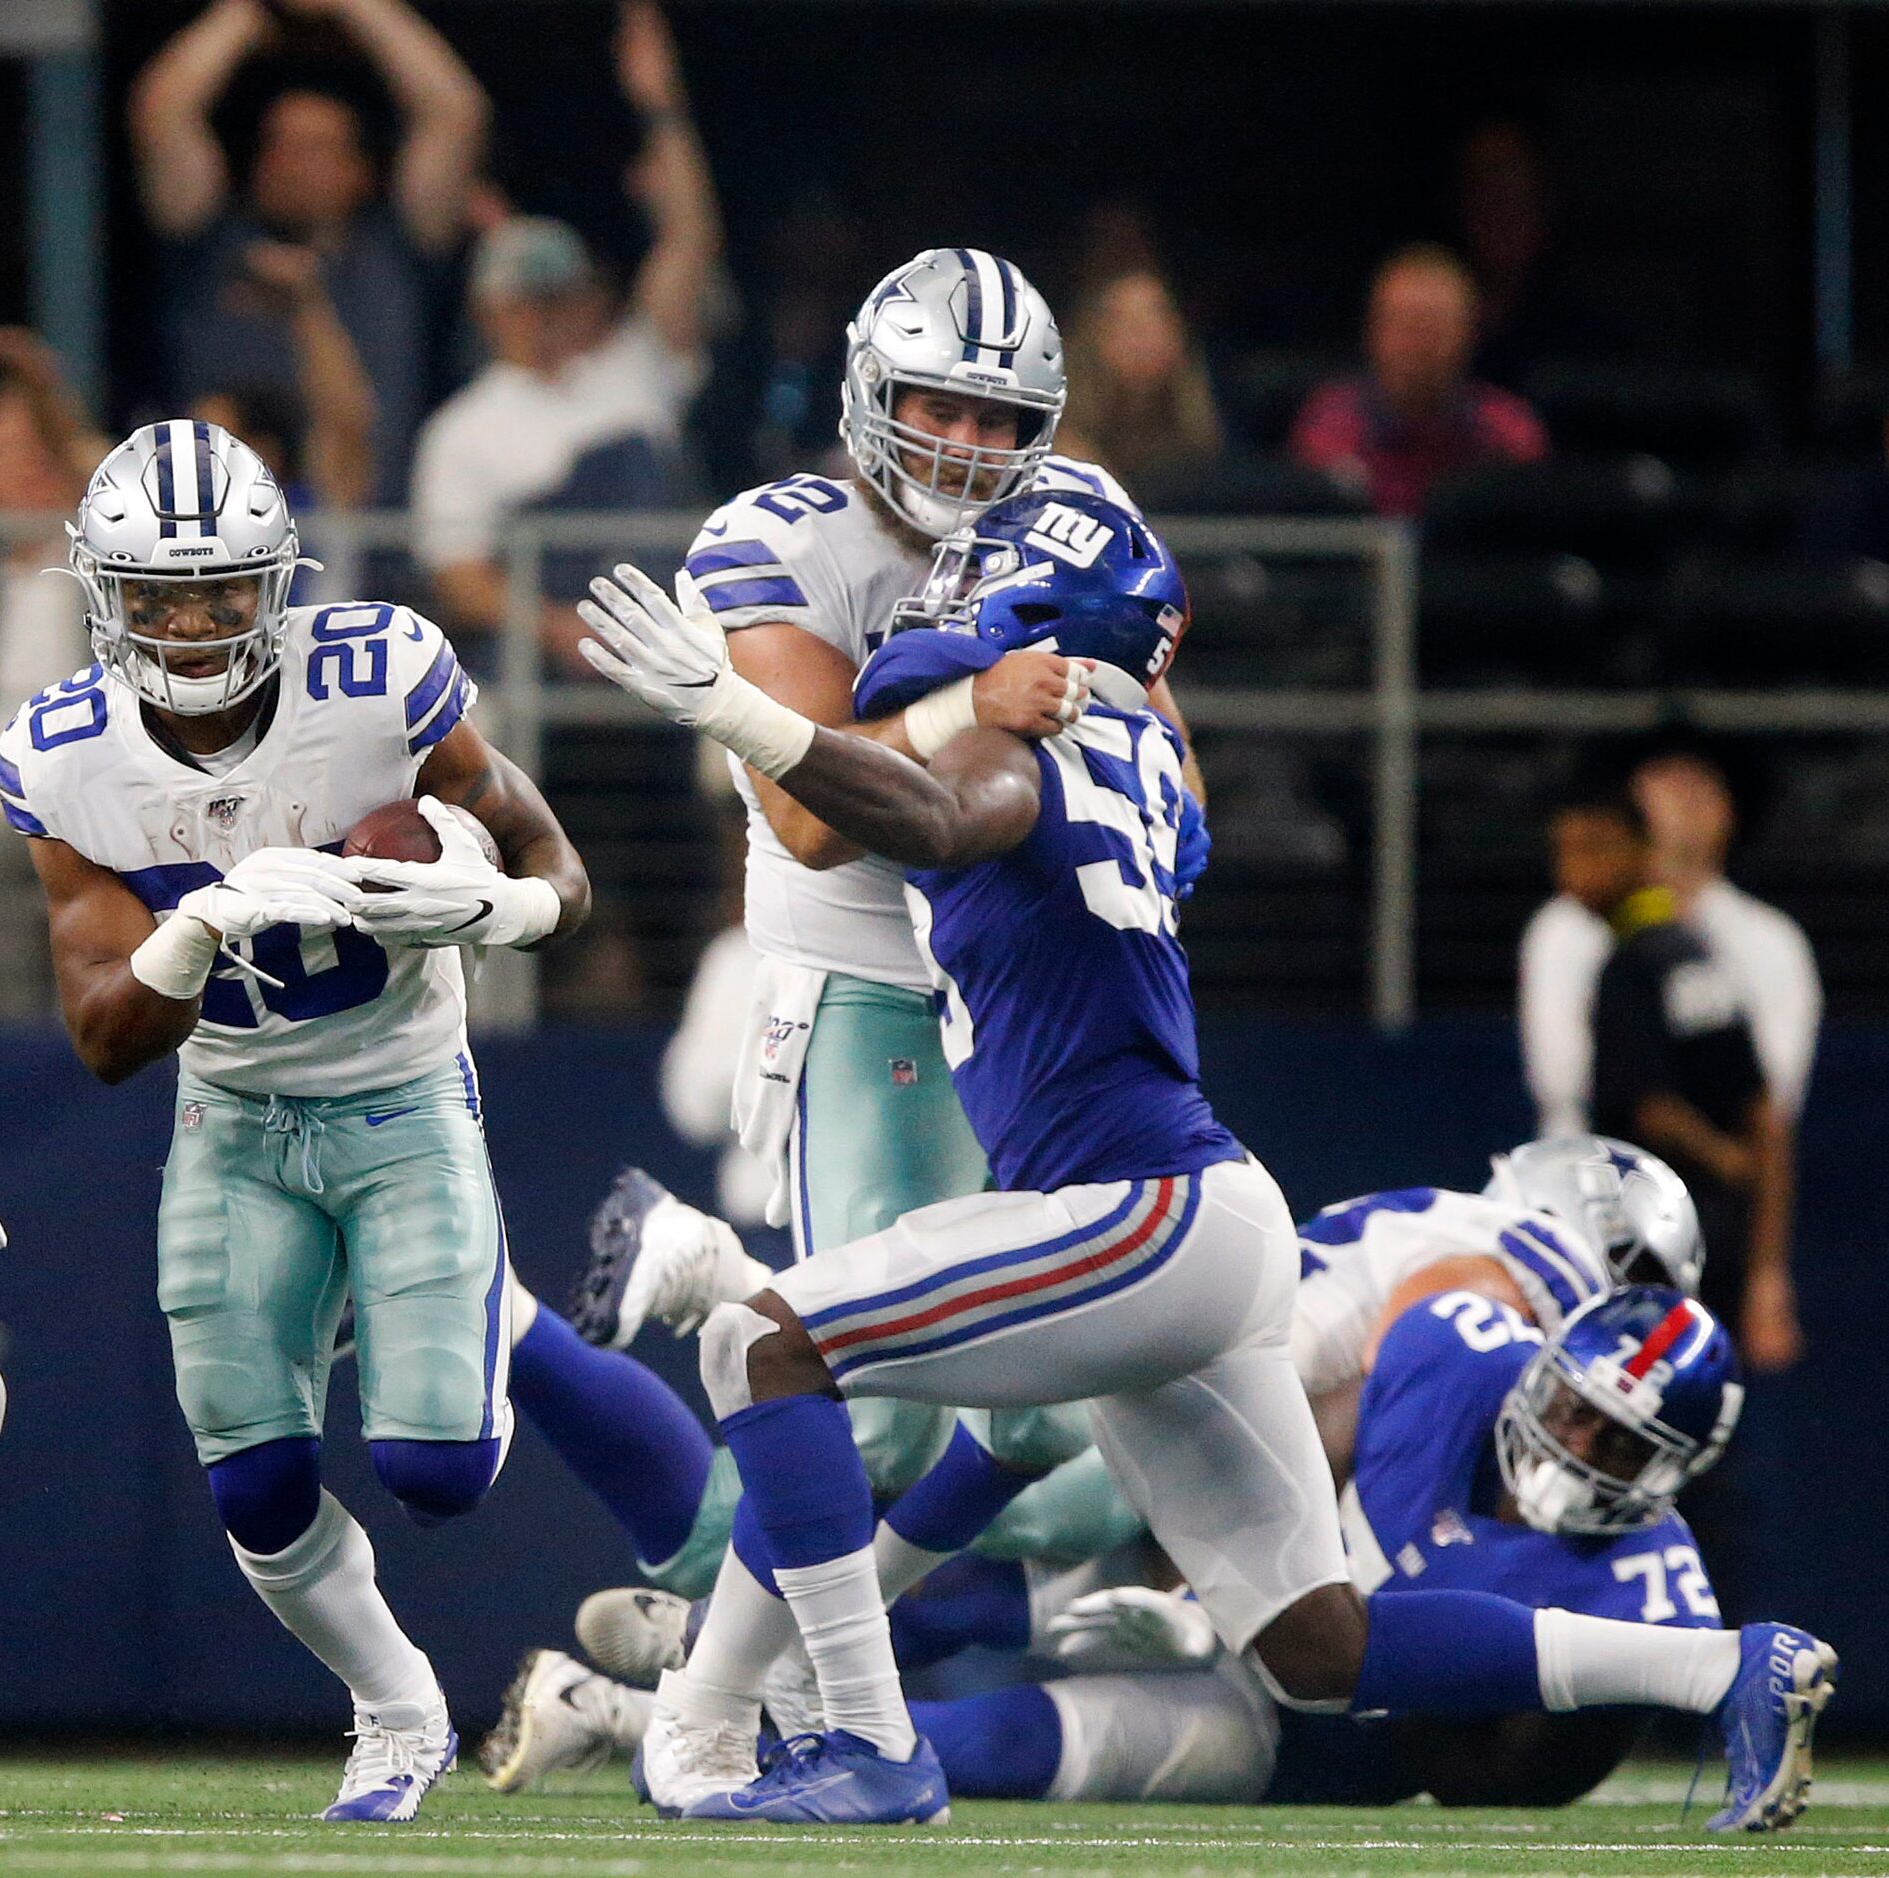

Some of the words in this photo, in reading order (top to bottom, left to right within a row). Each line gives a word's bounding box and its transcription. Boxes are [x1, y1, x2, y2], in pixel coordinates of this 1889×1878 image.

[169, 547, 214, 557] COWBOYS
[306, 602, 395, 699] 20
[1612, 1545, 1721, 1623] 72
